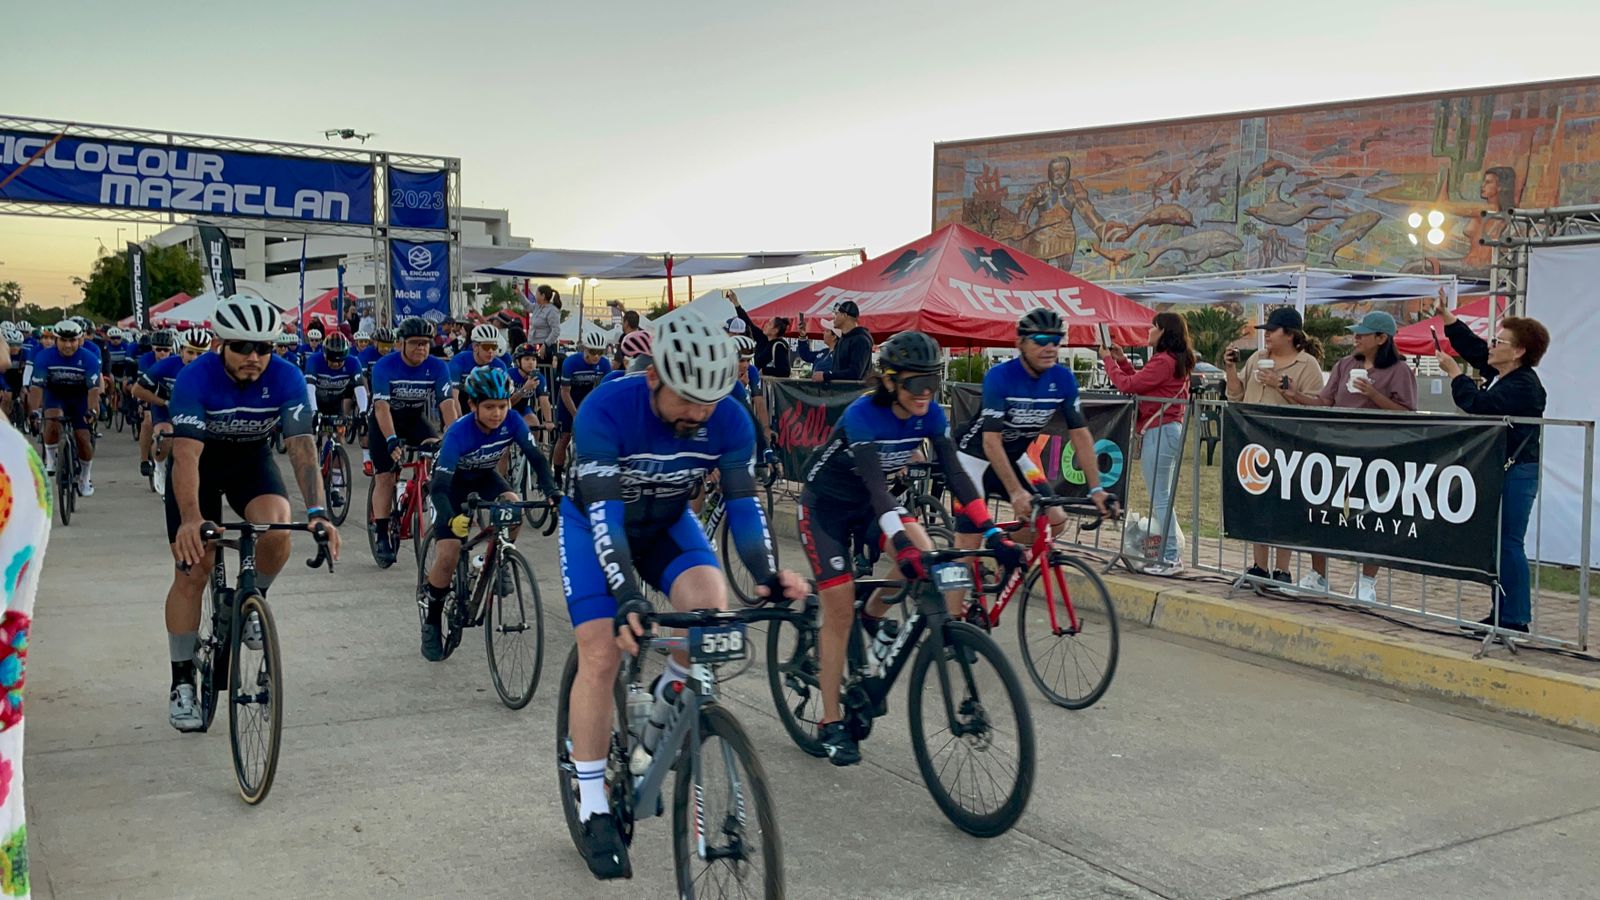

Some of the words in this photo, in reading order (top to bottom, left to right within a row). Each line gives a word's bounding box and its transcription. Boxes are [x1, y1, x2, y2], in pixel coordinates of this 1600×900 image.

[0, 135, 225, 182] ICLOTOUR
[100, 173, 349, 221] MAZATLAN
[391, 188, 445, 210] 2023
[949, 276, 1096, 317] TECATE
[1275, 447, 1477, 524] YOZOKO
[588, 500, 626, 591] AZATLAN
[1308, 508, 1418, 539] IZAKAYA
